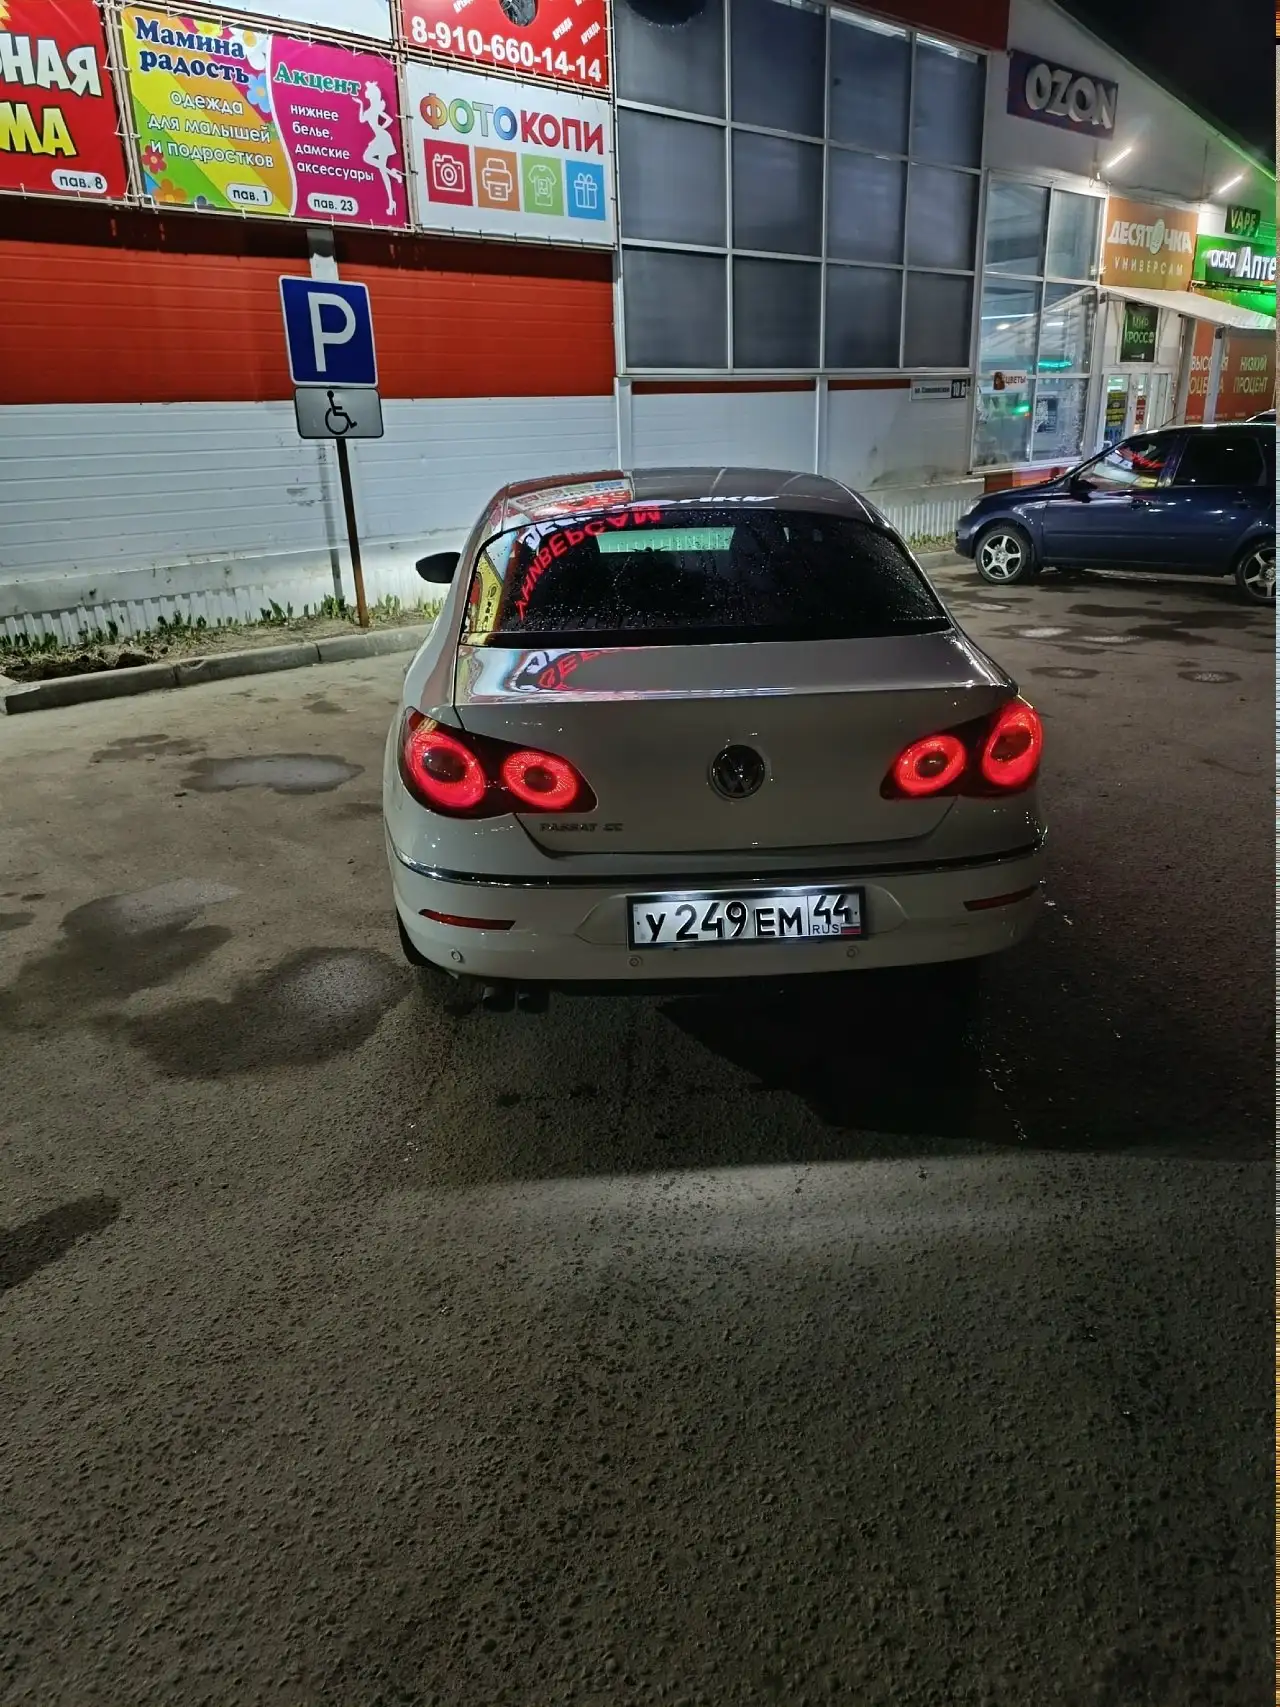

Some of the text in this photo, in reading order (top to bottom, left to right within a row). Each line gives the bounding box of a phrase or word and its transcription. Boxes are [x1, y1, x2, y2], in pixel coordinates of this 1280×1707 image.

[134, 16, 245, 60] Мамина
[411, 16, 602, 83] 8-910-660-14-14
[0, 33, 102, 97] НАЯ
[139, 48, 249, 84] радость
[274, 61, 361, 96] Акцент
[170, 90, 244, 116] одежда
[1025, 63, 1116, 130] OZON
[290, 104, 339, 121] нижнее
[419, 92, 604, 155] ФОТОКОПИ
[148, 114, 271, 144] для малышей
[292, 121, 333, 140] белье,
[150, 140, 274, 169] и подростков
[294, 144, 350, 160] дамские
[59, 175, 103, 190] пав. 8
[297, 161, 375, 182] аксессуары
[232, 188, 269, 203] пав. 1
[313, 197, 354, 212] пав. 23
[1231, 209, 1257, 233] VAPE
[1114, 255, 1183, 276] УНИВЕРСАМ
[307, 291, 357, 372] P
[813, 895, 850, 925] 44
[812, 922, 840, 935] RUS
